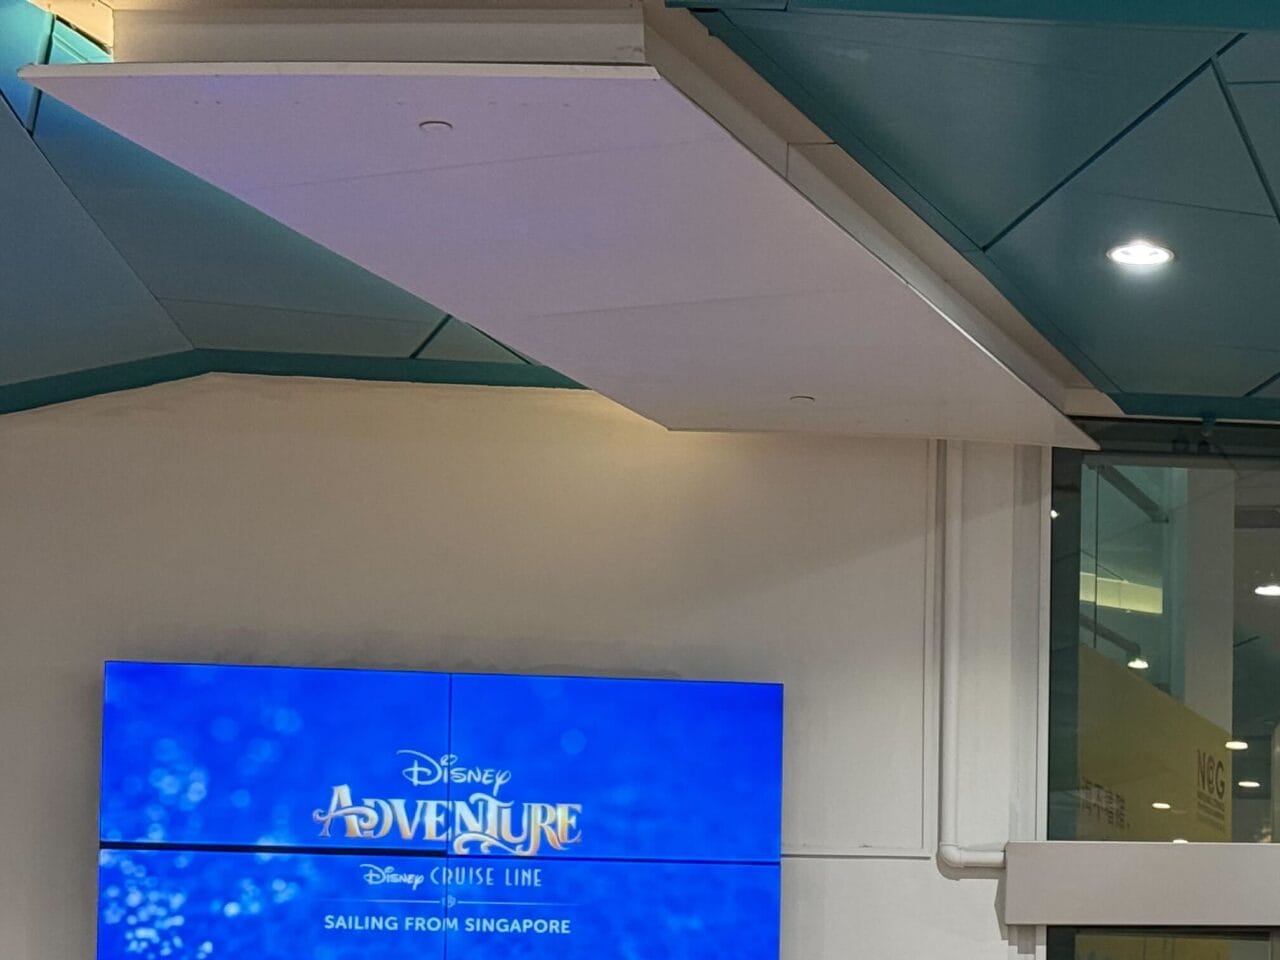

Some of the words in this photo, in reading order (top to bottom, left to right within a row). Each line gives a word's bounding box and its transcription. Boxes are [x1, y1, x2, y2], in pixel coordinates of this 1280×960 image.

[396, 749, 512, 796] Disney
[312, 783, 583, 857] ADVENTURE
[359, 863, 425, 891] Disney
[430, 866, 495, 887] CRUISE
[505, 867, 542, 888] LINE
[323, 914, 399, 931] SAILING
[404, 916, 459, 933] FROM
[464, 917, 572, 935] SINGAPORE
